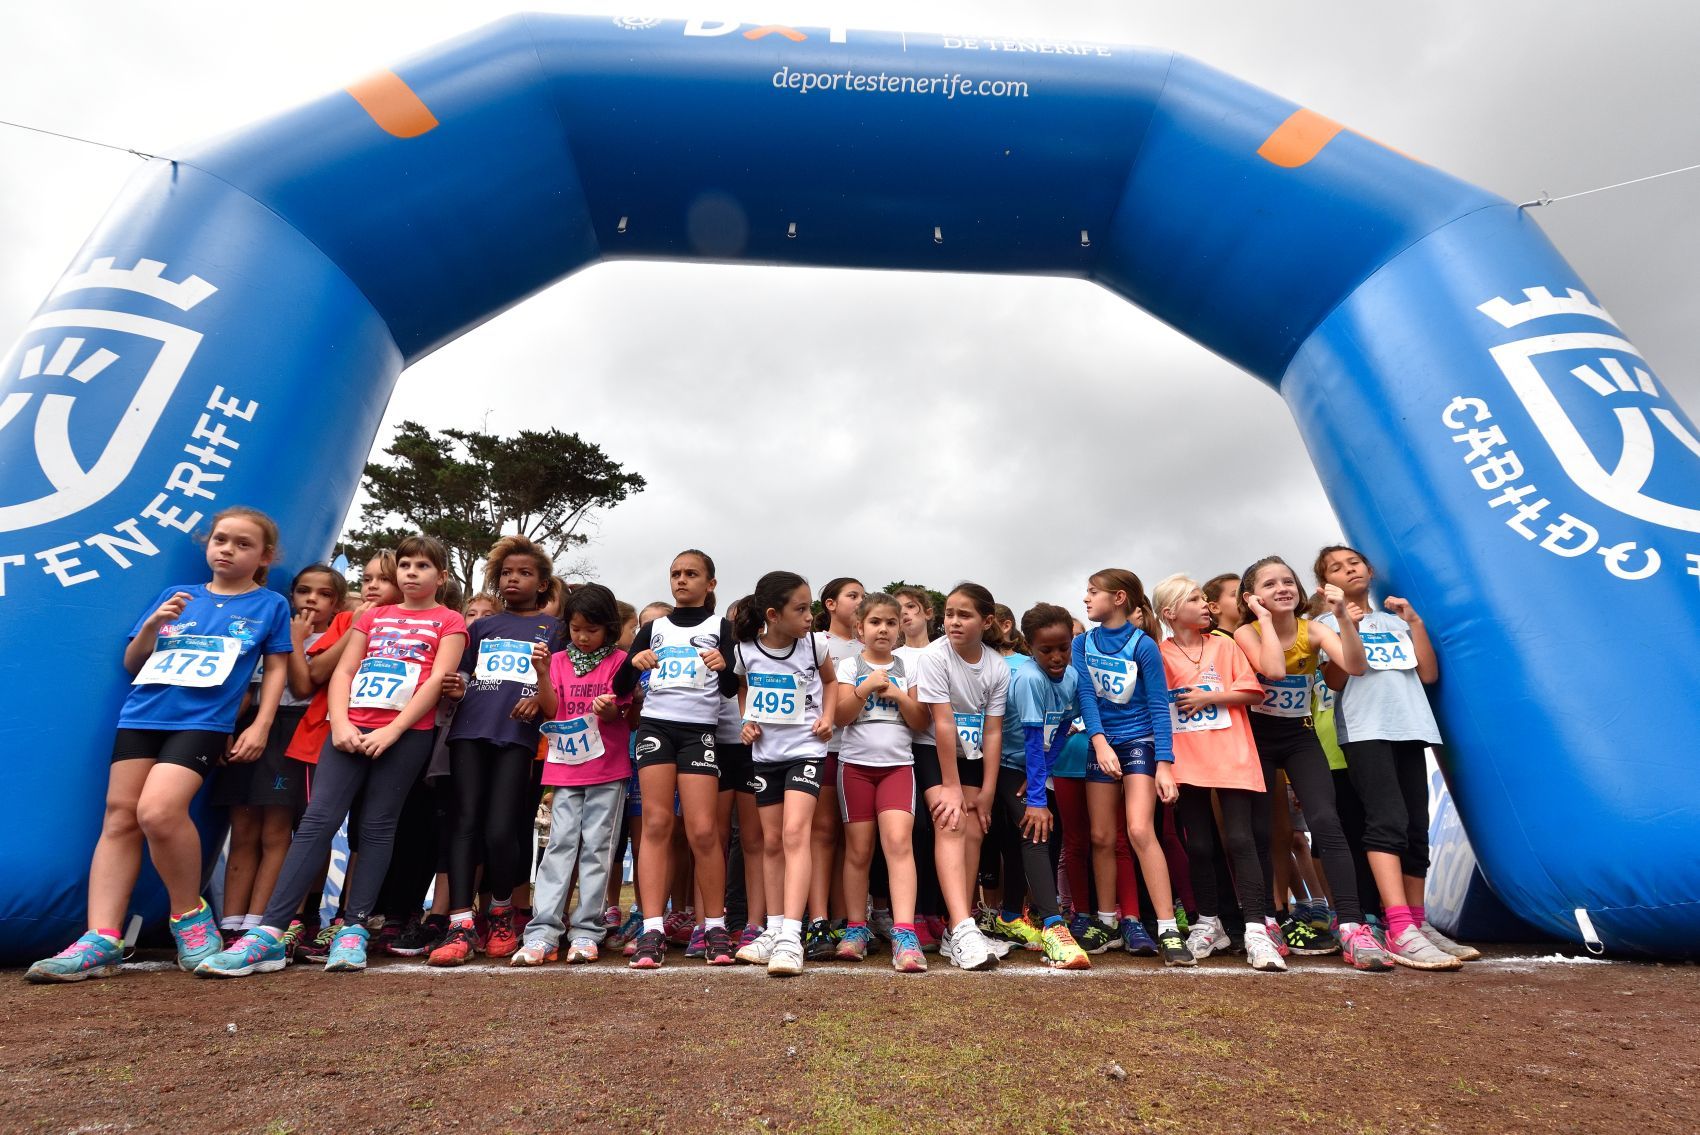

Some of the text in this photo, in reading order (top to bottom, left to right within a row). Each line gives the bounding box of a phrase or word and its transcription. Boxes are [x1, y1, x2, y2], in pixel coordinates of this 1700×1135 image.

[772, 66, 1029, 99] deportestenerife.com
[1441, 395, 1661, 580] CABILDO
[1363, 645, 1407, 662] 234
[154, 653, 219, 677] 475
[487, 655, 530, 675] 699
[657, 660, 697, 680] 494
[356, 677, 403, 698] 257
[1094, 671, 1125, 695] 165
[753, 691, 795, 714] 495
[1263, 689, 1306, 709] 232
[557, 734, 590, 756] 441
